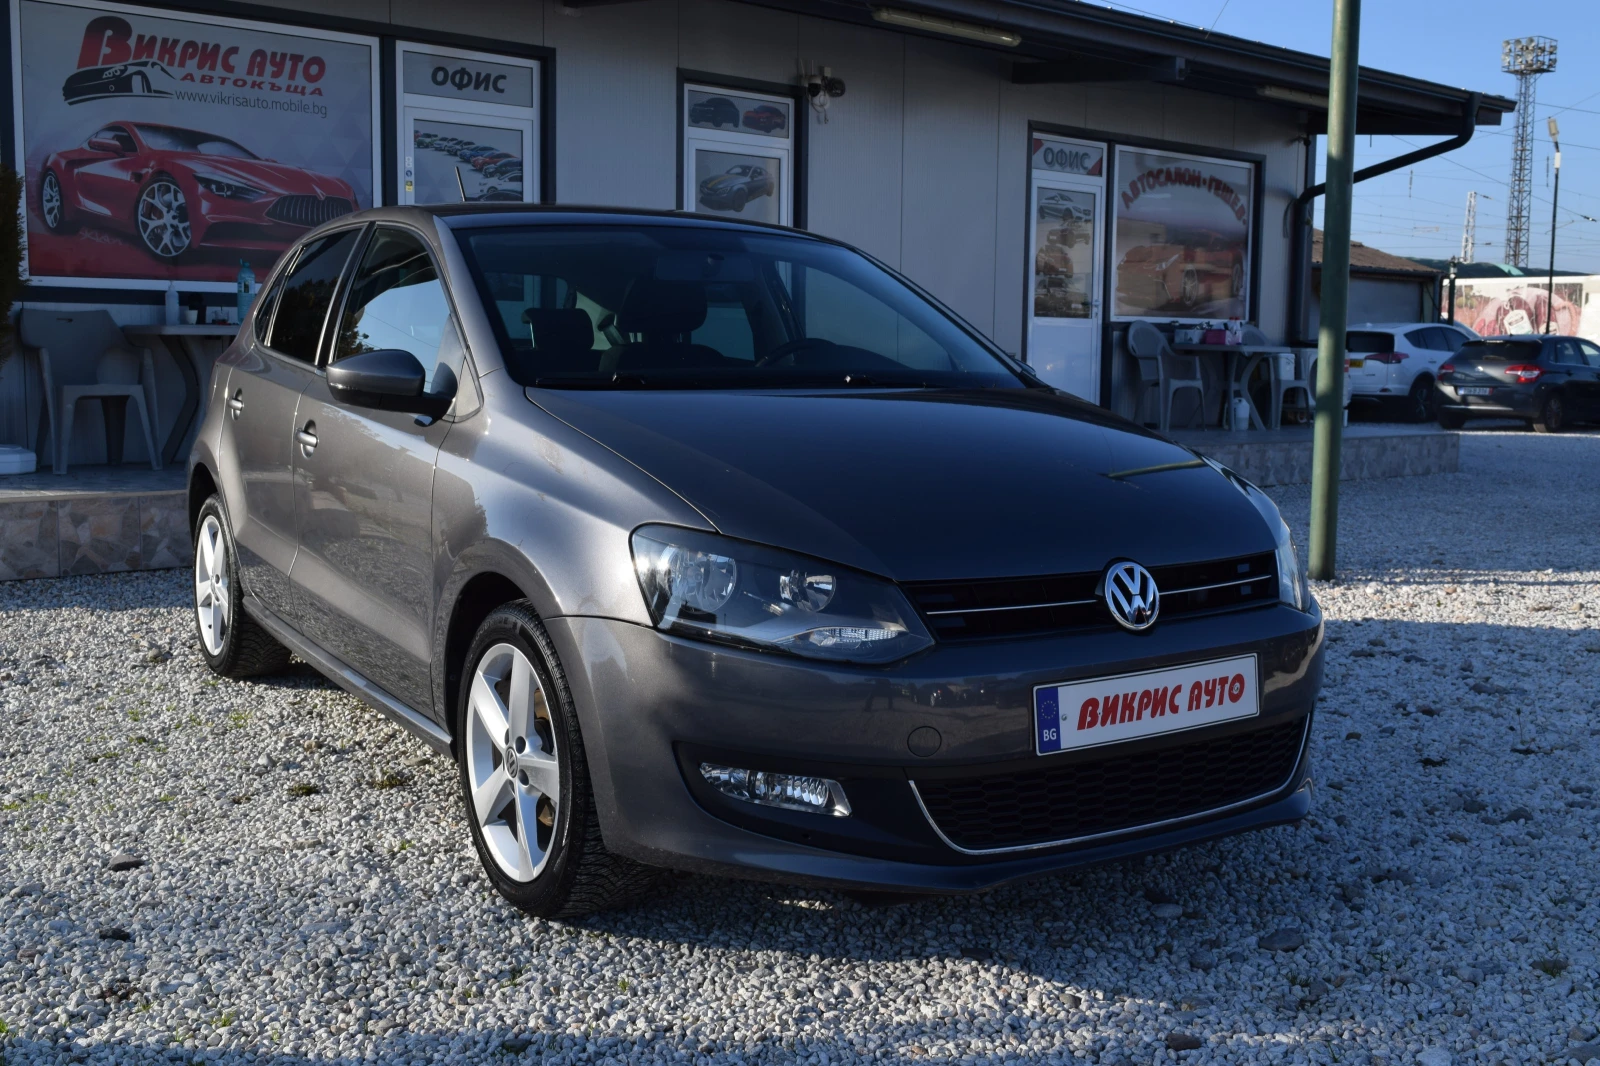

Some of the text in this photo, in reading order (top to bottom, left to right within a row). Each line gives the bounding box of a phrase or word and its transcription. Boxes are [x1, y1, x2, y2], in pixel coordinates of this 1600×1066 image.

[77, 15, 327, 84] ВИКРИС АУТО
[180, 72, 324, 97] АВТОКЪЩА
[431, 66, 508, 94] ОФИС
[175, 90, 328, 119] www.vikrisauto.mobile.bg
[1043, 146, 1091, 171] ОФИС
[1077, 673, 1245, 731] ВИКРИС АУТО
[1043, 728, 1057, 742] BG
